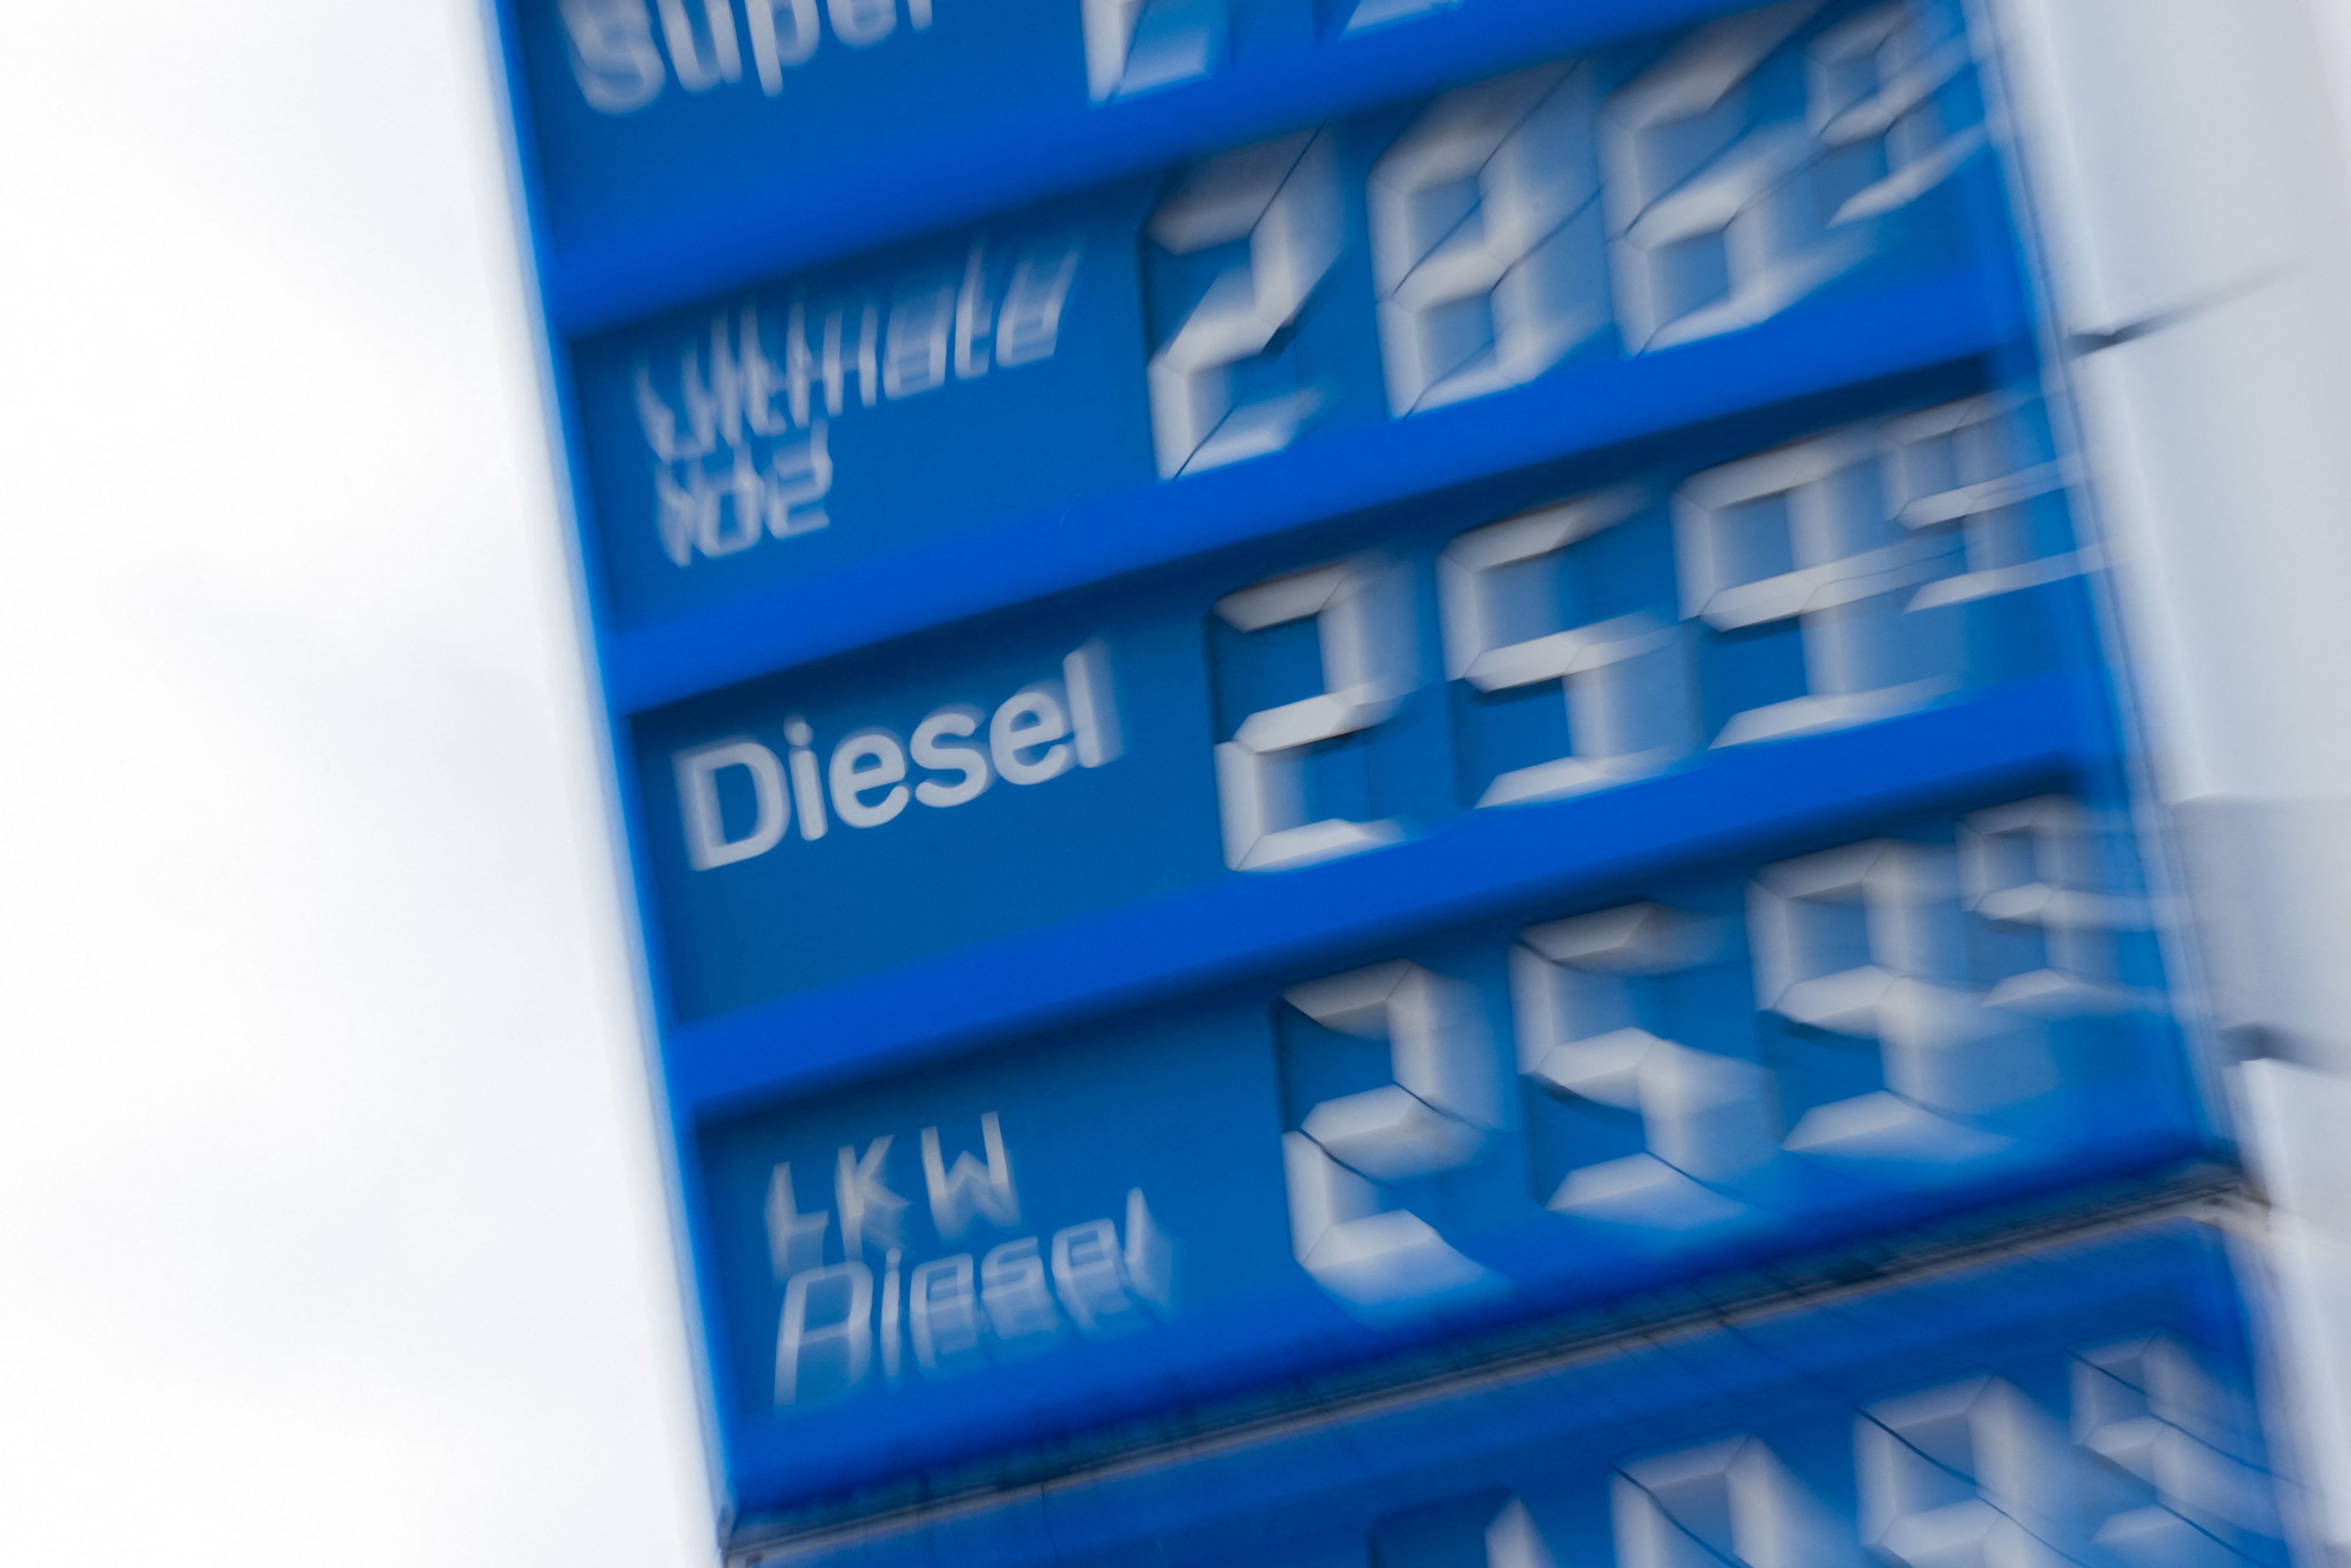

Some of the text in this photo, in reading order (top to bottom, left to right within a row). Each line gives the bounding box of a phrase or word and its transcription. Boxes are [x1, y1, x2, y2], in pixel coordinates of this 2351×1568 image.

[672, 638, 1120, 871] Diesel
[765, 1111, 1020, 1272] LKW
[773, 1186, 1176, 1408] Diesel
